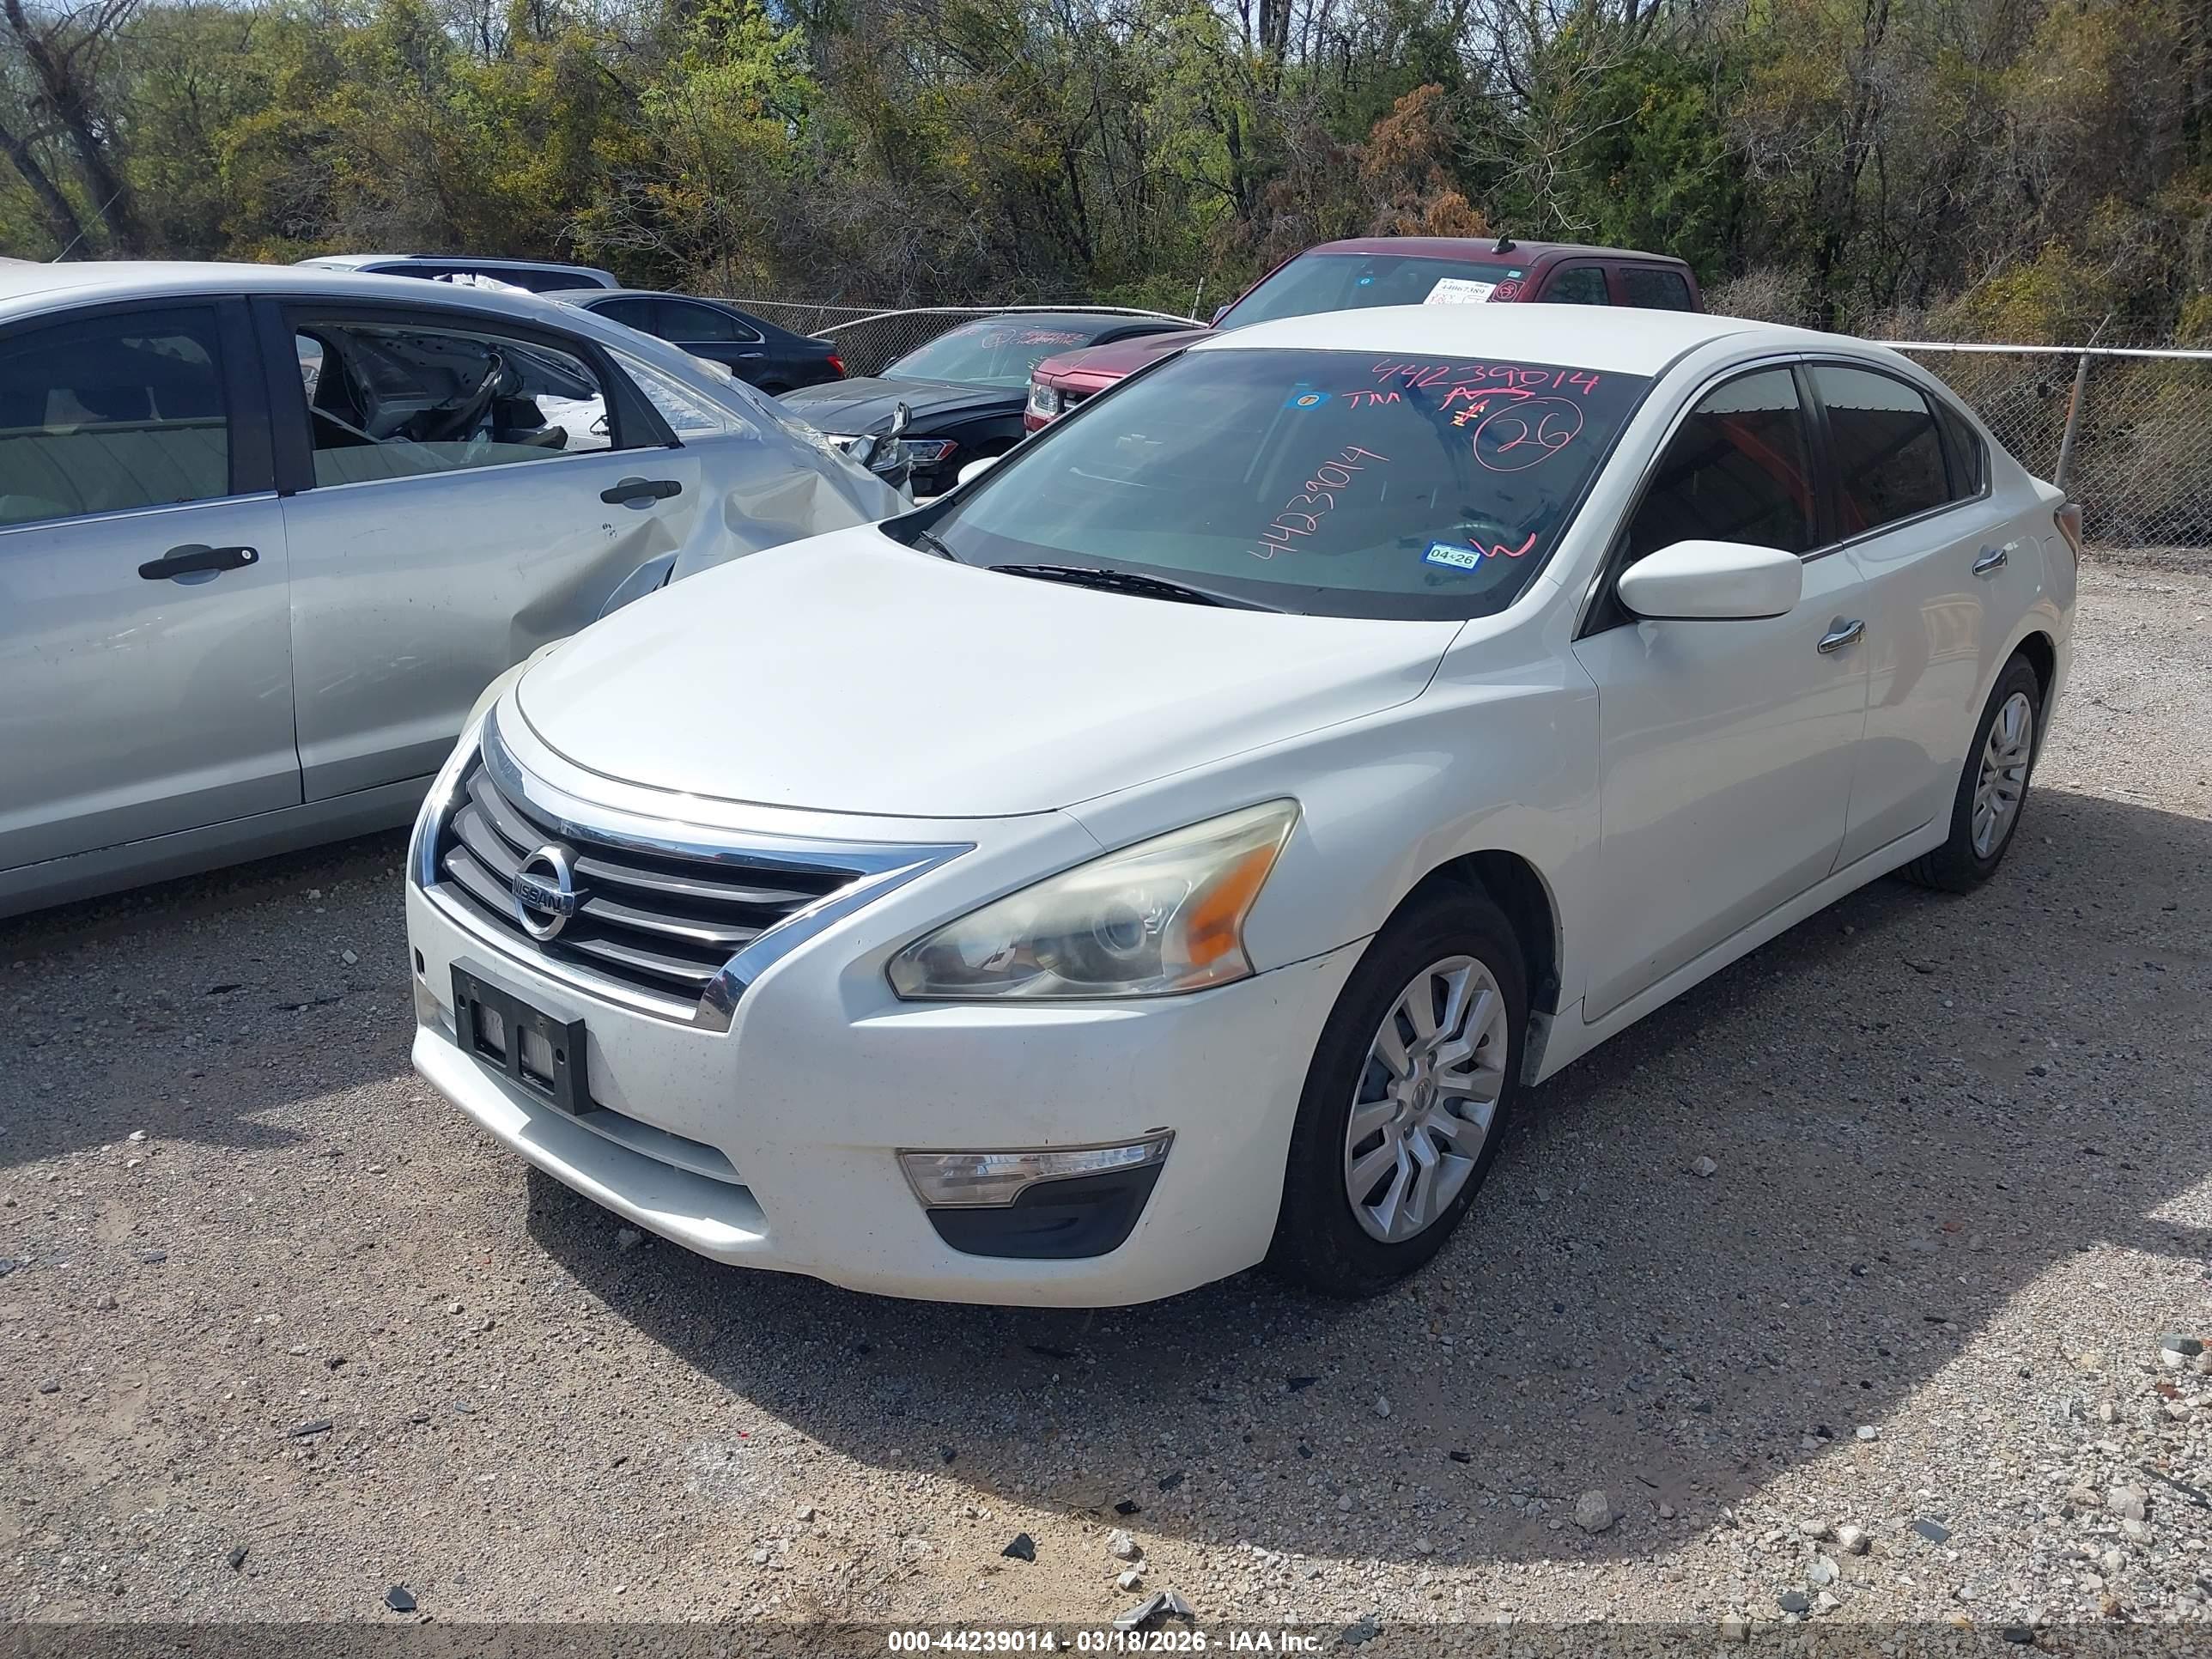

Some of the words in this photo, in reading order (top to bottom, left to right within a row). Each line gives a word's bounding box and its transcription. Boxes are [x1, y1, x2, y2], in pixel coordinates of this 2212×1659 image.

[1371, 359, 1600, 396] 44239014
[1495, 413, 1570, 448] 26
[1247, 446, 1391, 560] 44239014
[514, 878, 562, 912] NISSAN
